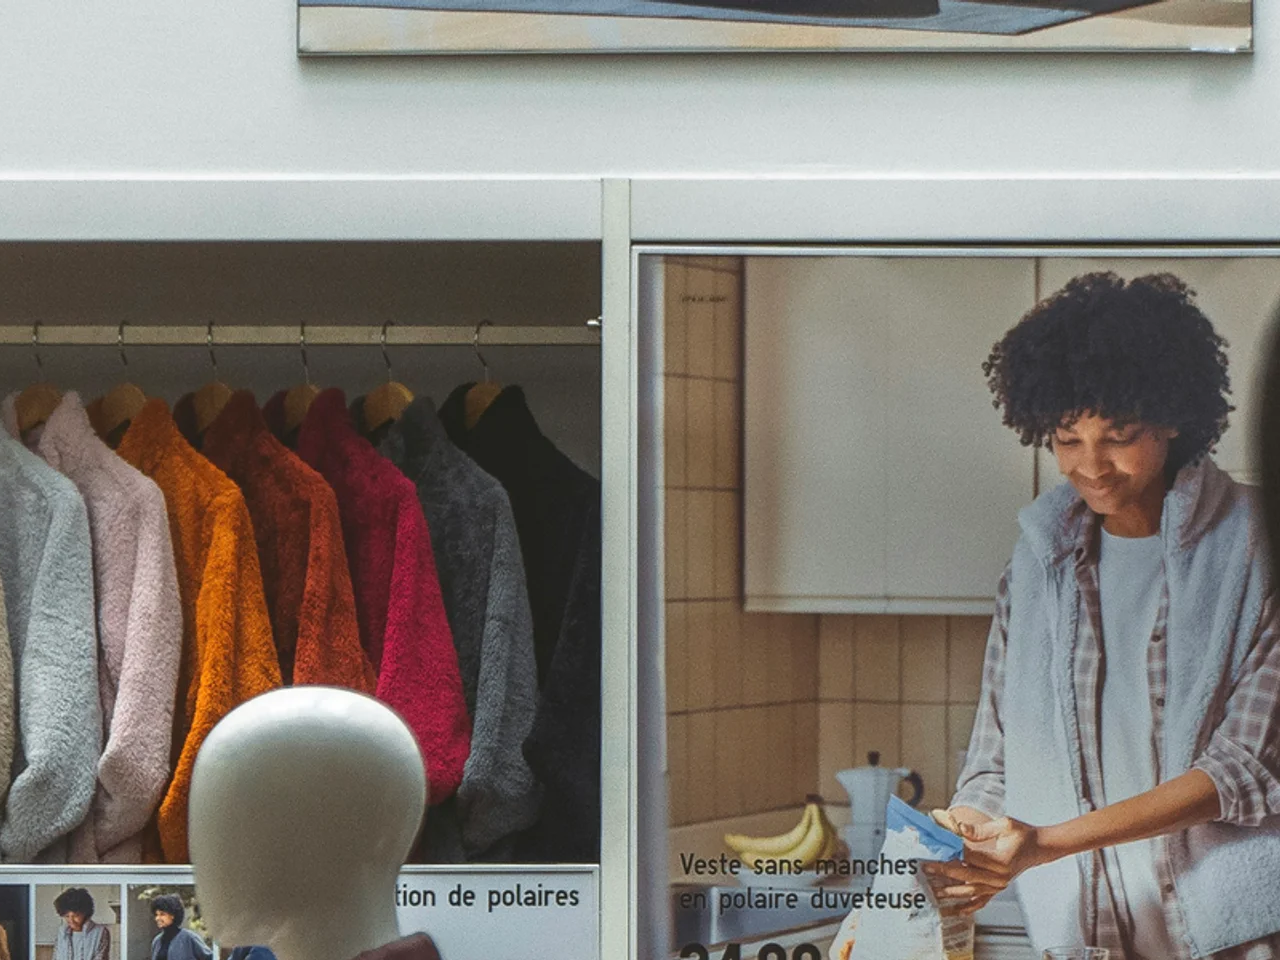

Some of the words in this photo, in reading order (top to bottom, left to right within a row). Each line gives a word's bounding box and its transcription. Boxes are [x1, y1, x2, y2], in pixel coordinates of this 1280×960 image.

[680, 853, 742, 875] Veste
[753, 858, 803, 876] sans
[816, 853, 919, 876] manches
[448, 884, 475, 907] de
[488, 884, 580, 913] polaires
[680, 892, 706, 910] en
[720, 886, 798, 915] polaire
[810, 887, 927, 910] duveteuse
